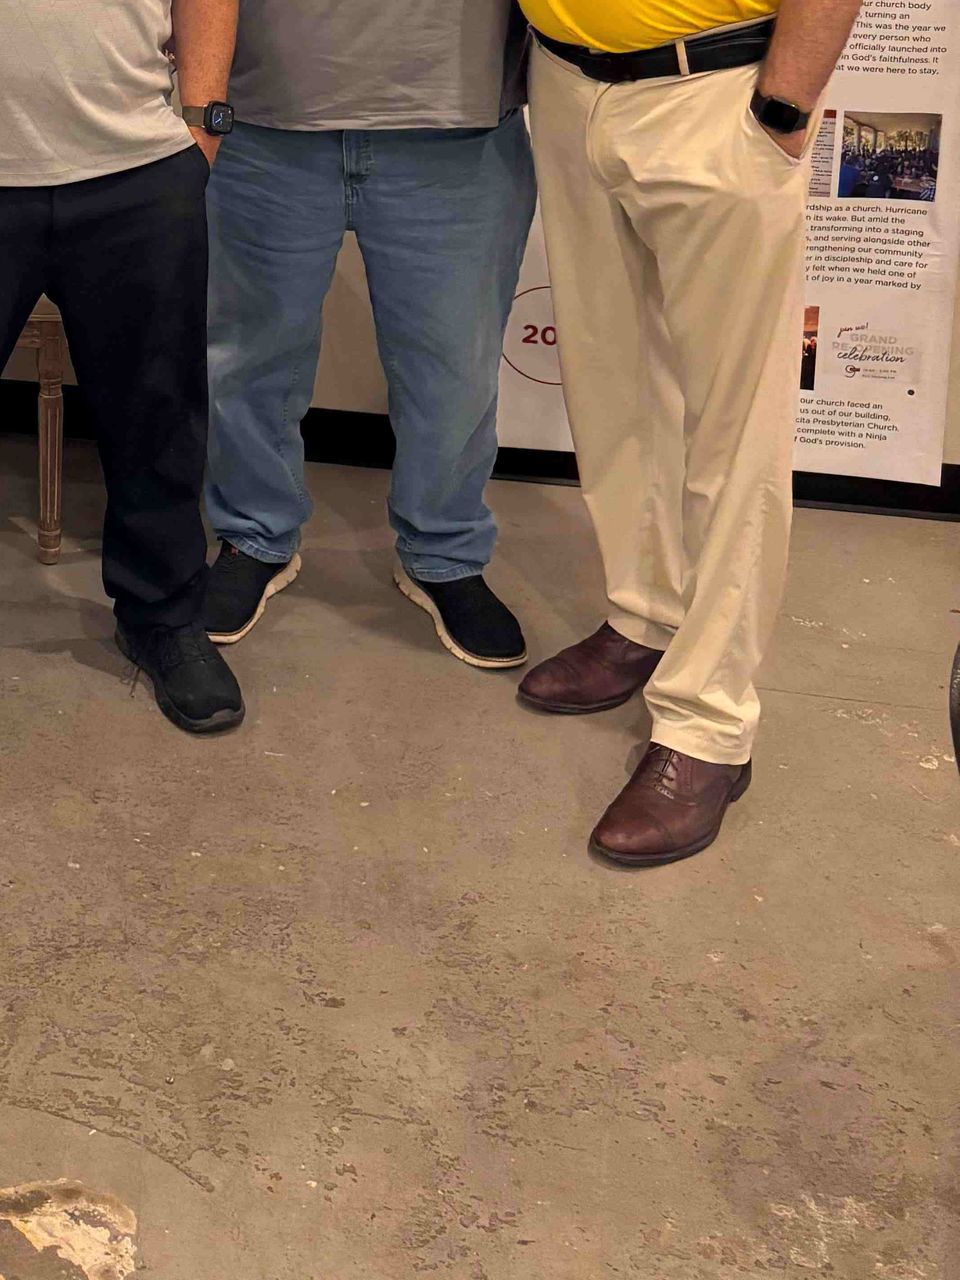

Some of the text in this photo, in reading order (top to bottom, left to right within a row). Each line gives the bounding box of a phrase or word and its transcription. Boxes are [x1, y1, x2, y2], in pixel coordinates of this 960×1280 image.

[849, 43, 886, 53] officially
[888, 45, 929, 53] launched
[851, 53, 878, 63] God's
[879, 55, 930, 64] faithfulness.
[810, 225, 863, 234] transforming
[891, 228, 924, 238] staging
[831, 236, 862, 244] serving
[863, 236, 906, 246] alongside
[907, 239, 931, 248] other
[522, 324, 557, 346] 20
[850, 333, 897, 345] GRAND
[837, 346, 905, 363] celebration
[816, 399, 845, 407] church
[847, 401, 871, 409] faced
[813, 418, 899, 432] Presbyterian Church.
